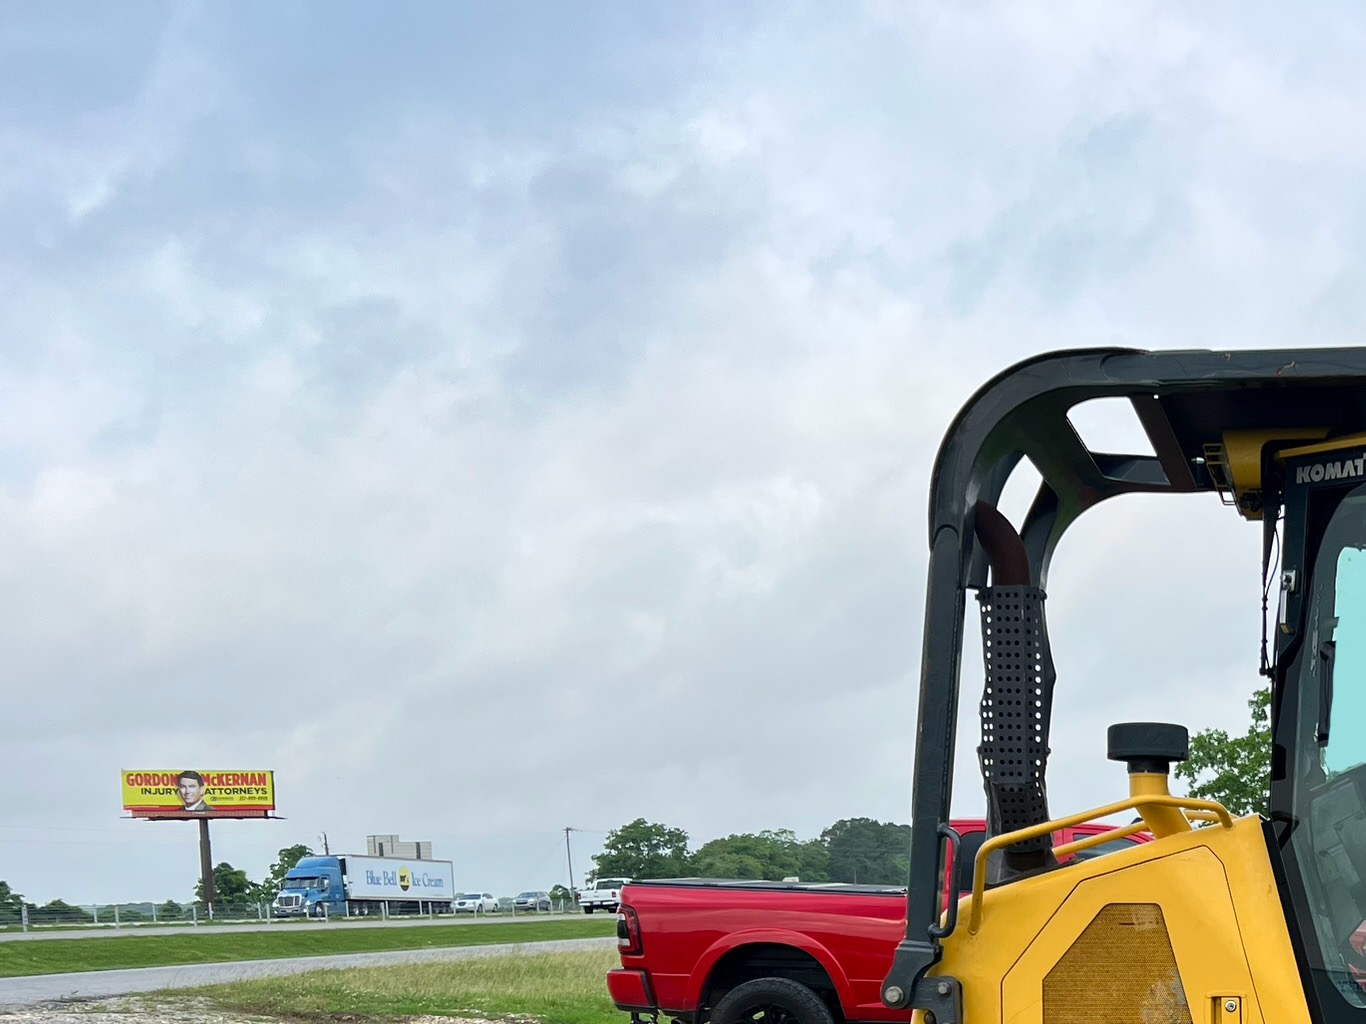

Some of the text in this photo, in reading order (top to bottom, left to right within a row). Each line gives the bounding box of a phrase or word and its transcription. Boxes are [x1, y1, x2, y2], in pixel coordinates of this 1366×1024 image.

[126, 772, 267, 787] GORDON McKERNAN
[140, 787, 268, 796] INJURY ATTORNEYS
[365, 870, 444, 888] Blue Bell Ice Cream
